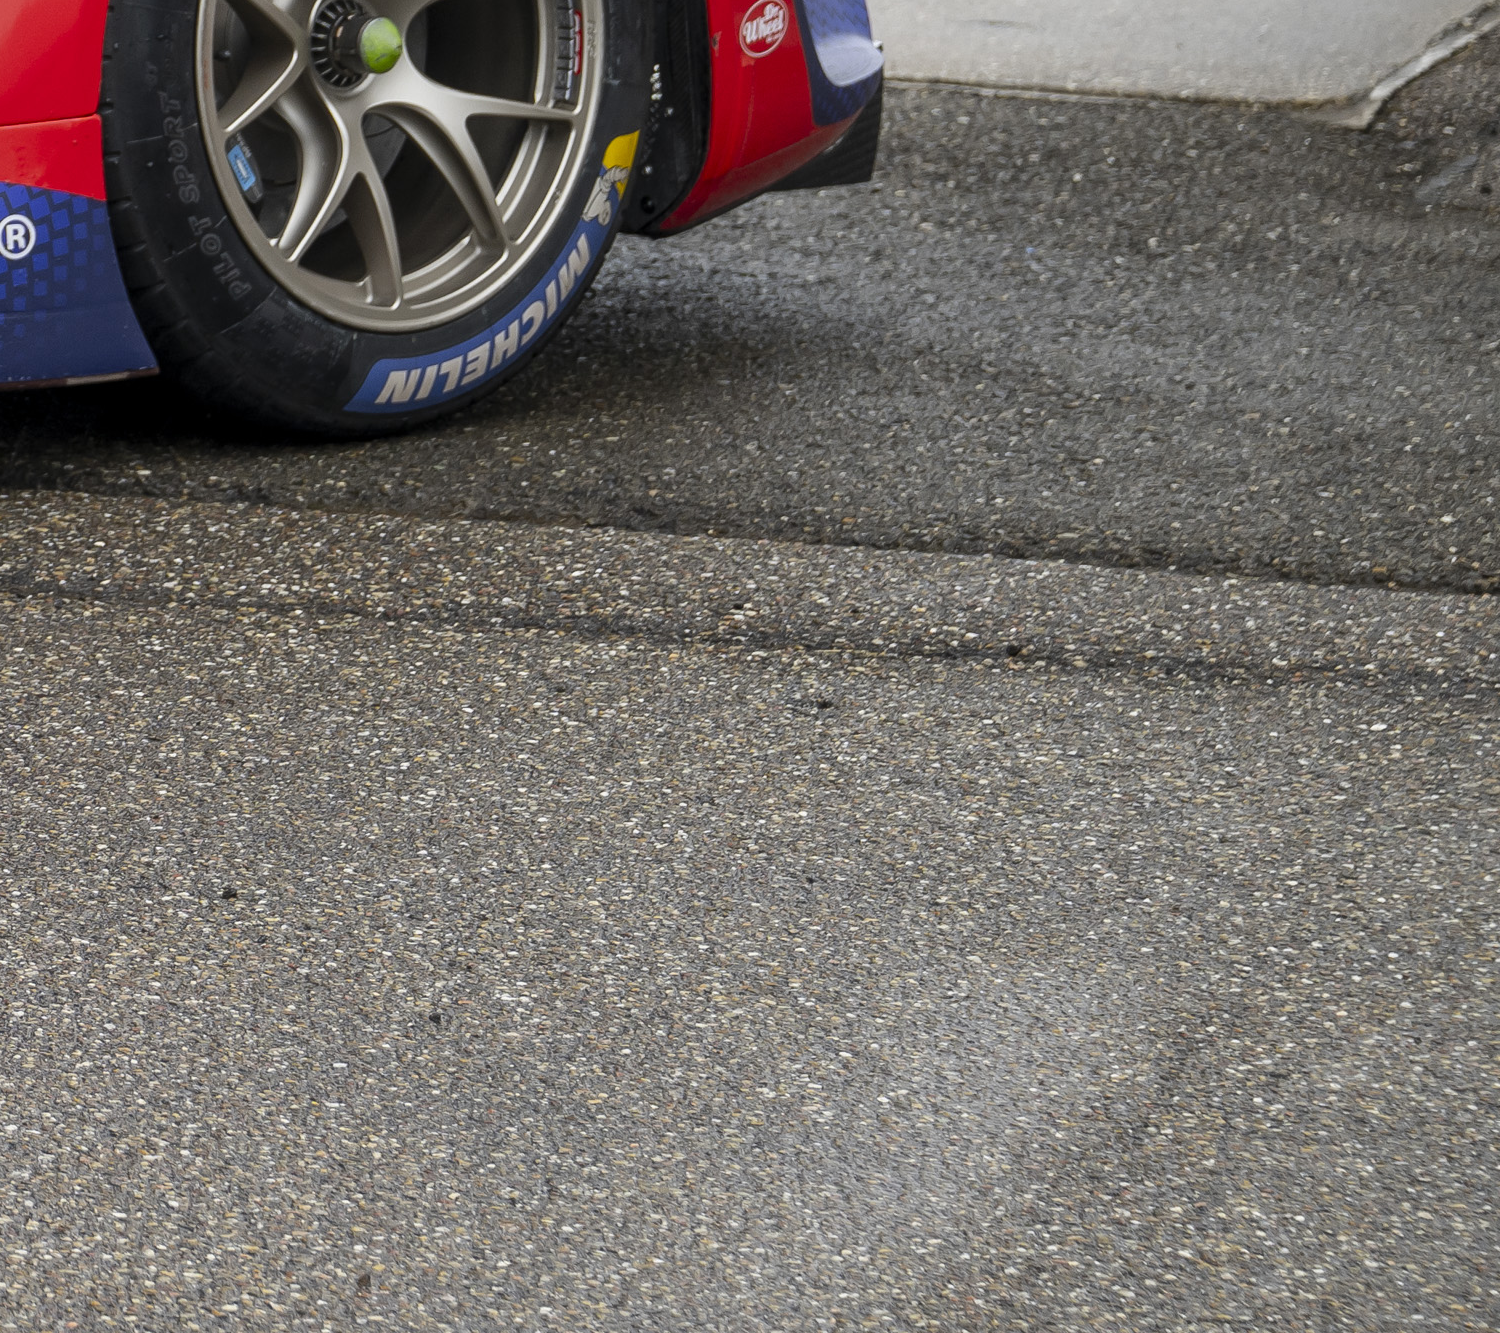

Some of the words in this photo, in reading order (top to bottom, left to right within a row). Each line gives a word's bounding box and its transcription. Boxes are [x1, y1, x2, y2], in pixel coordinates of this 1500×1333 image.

[156, 90, 201, 205] SPORT
[187, 215, 252, 301] PILOT
[373, 232, 591, 405] MICHELIN
